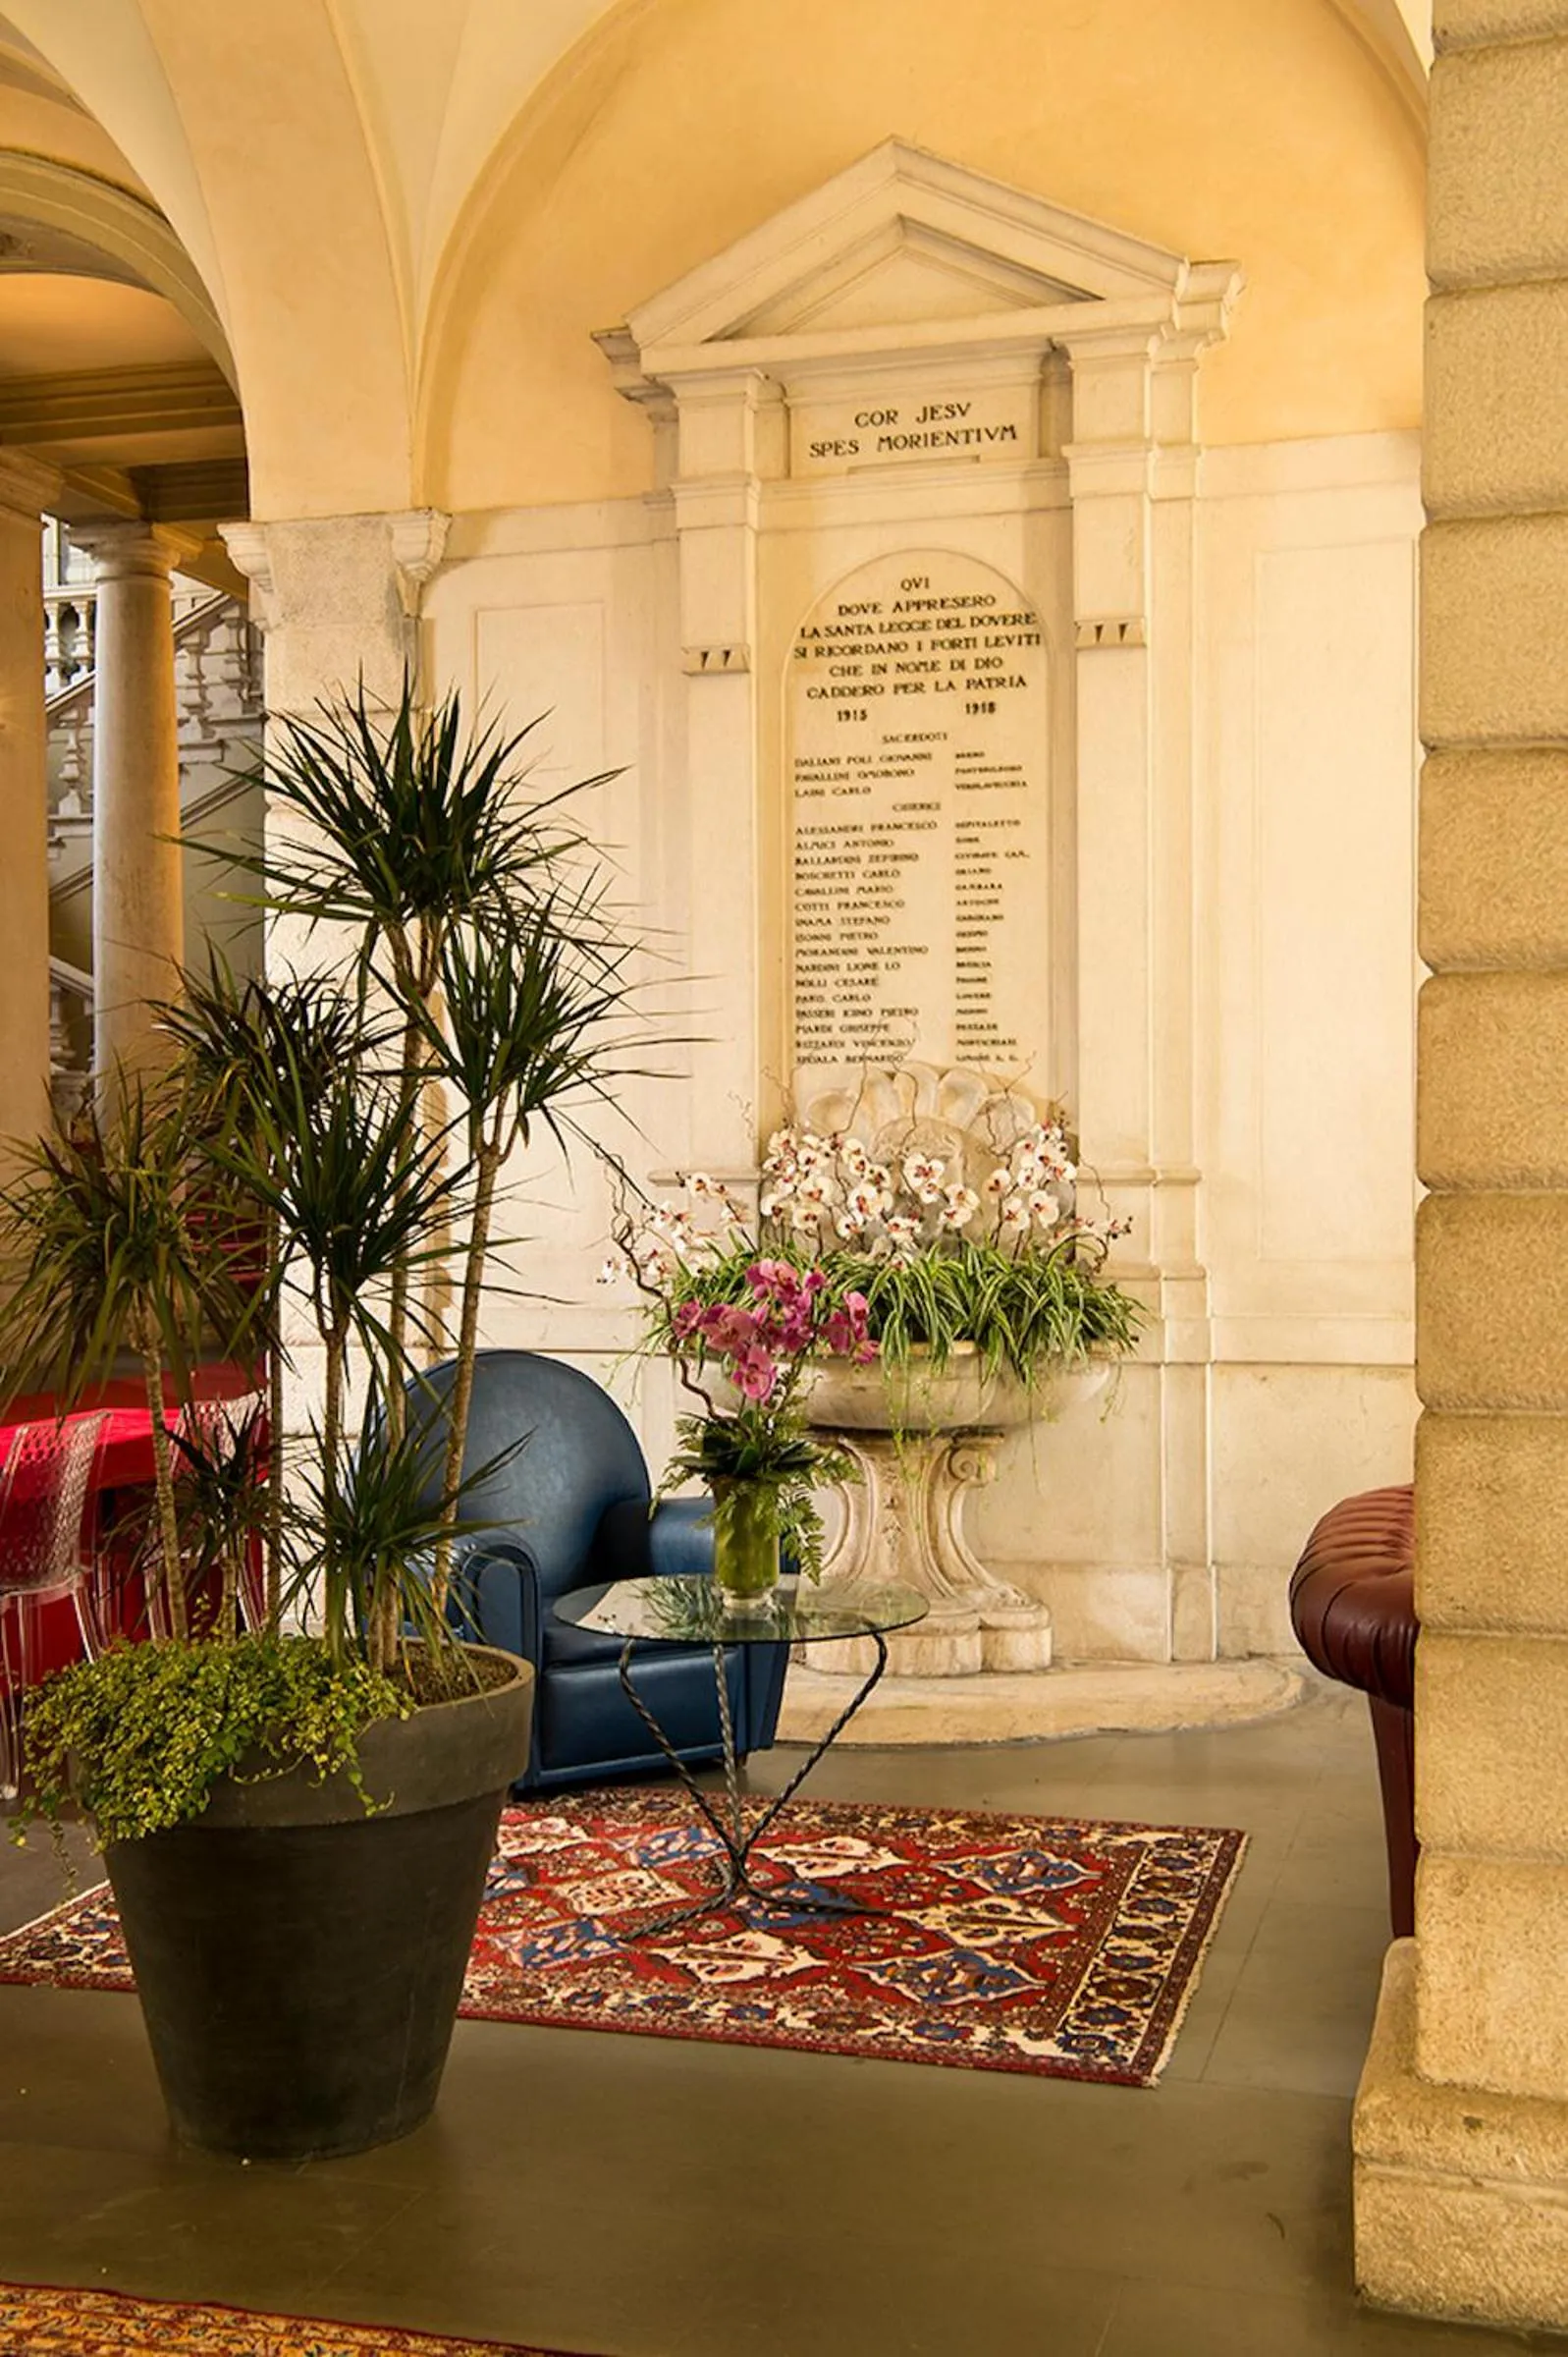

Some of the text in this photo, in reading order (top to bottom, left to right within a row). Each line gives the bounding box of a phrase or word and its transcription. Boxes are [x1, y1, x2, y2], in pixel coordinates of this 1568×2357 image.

[854, 403, 971, 428] COR JESV
[810, 424, 1017, 458] SPES MORIENTIVM
[900, 577, 929, 592] QVI
[838, 595, 996, 617] DOVE APPRESERO
[800, 612, 1038, 639] LA SANTA LEGGE DEL DOVERE
[794, 633, 1041, 659] SI RICORDANO I FORTI LEVITI
[829, 657, 1003, 677] CHE IN NOME DI DIO
[807, 676, 1026, 699] CADDERO PER LA PATRIA
[838, 701, 996, 722] 1915 1918
[880, 753, 932, 762] GIOVANNI
[871, 821, 937, 831] FRANCESCO
[862, 869, 900, 878] CARLO
[838, 901, 904, 909] FRANCESCO
[835, 978, 878, 987] CESARE
